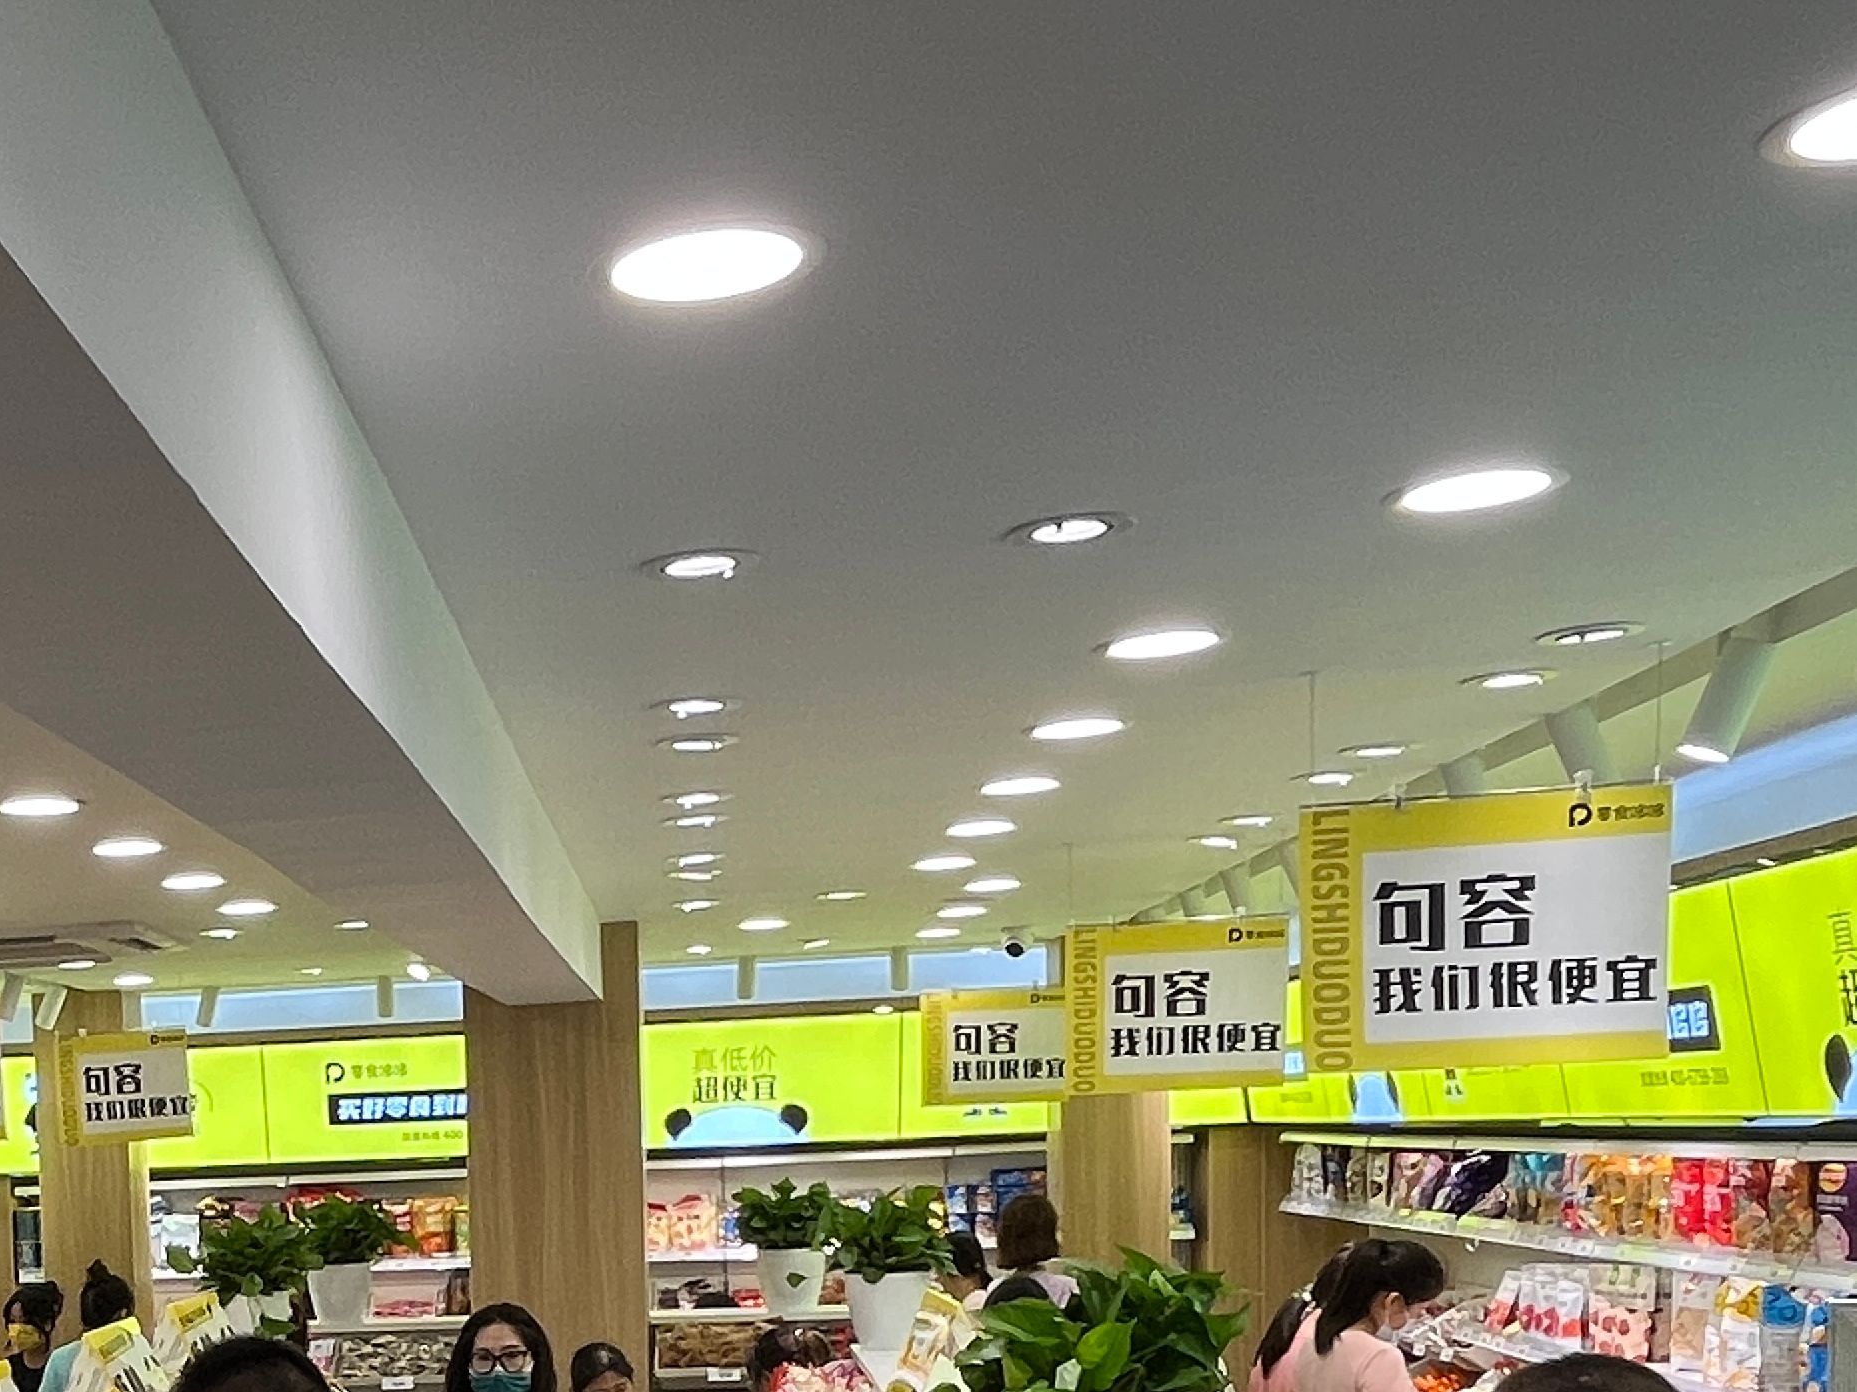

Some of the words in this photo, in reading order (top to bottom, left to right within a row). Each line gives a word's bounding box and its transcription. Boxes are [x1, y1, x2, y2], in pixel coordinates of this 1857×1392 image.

[1372, 874, 1537, 952] 句容
[1312, 809, 1354, 1071] LINGSHIDUODUO
[1111, 970, 1210, 1018] 句容
[1373, 955, 1658, 1015] 我们很便宜
[953, 1023, 1018, 1056] 句容
[1111, 1022, 1282, 1058] 我们很便宜
[692, 1045, 777, 1073] 真低价
[952, 1057, 1065, 1082] 我们很便宜
[83, 1063, 142, 1096] 句容
[692, 1074, 777, 1103] 超便宜
[86, 1094, 198, 1123] 我们很便宜
